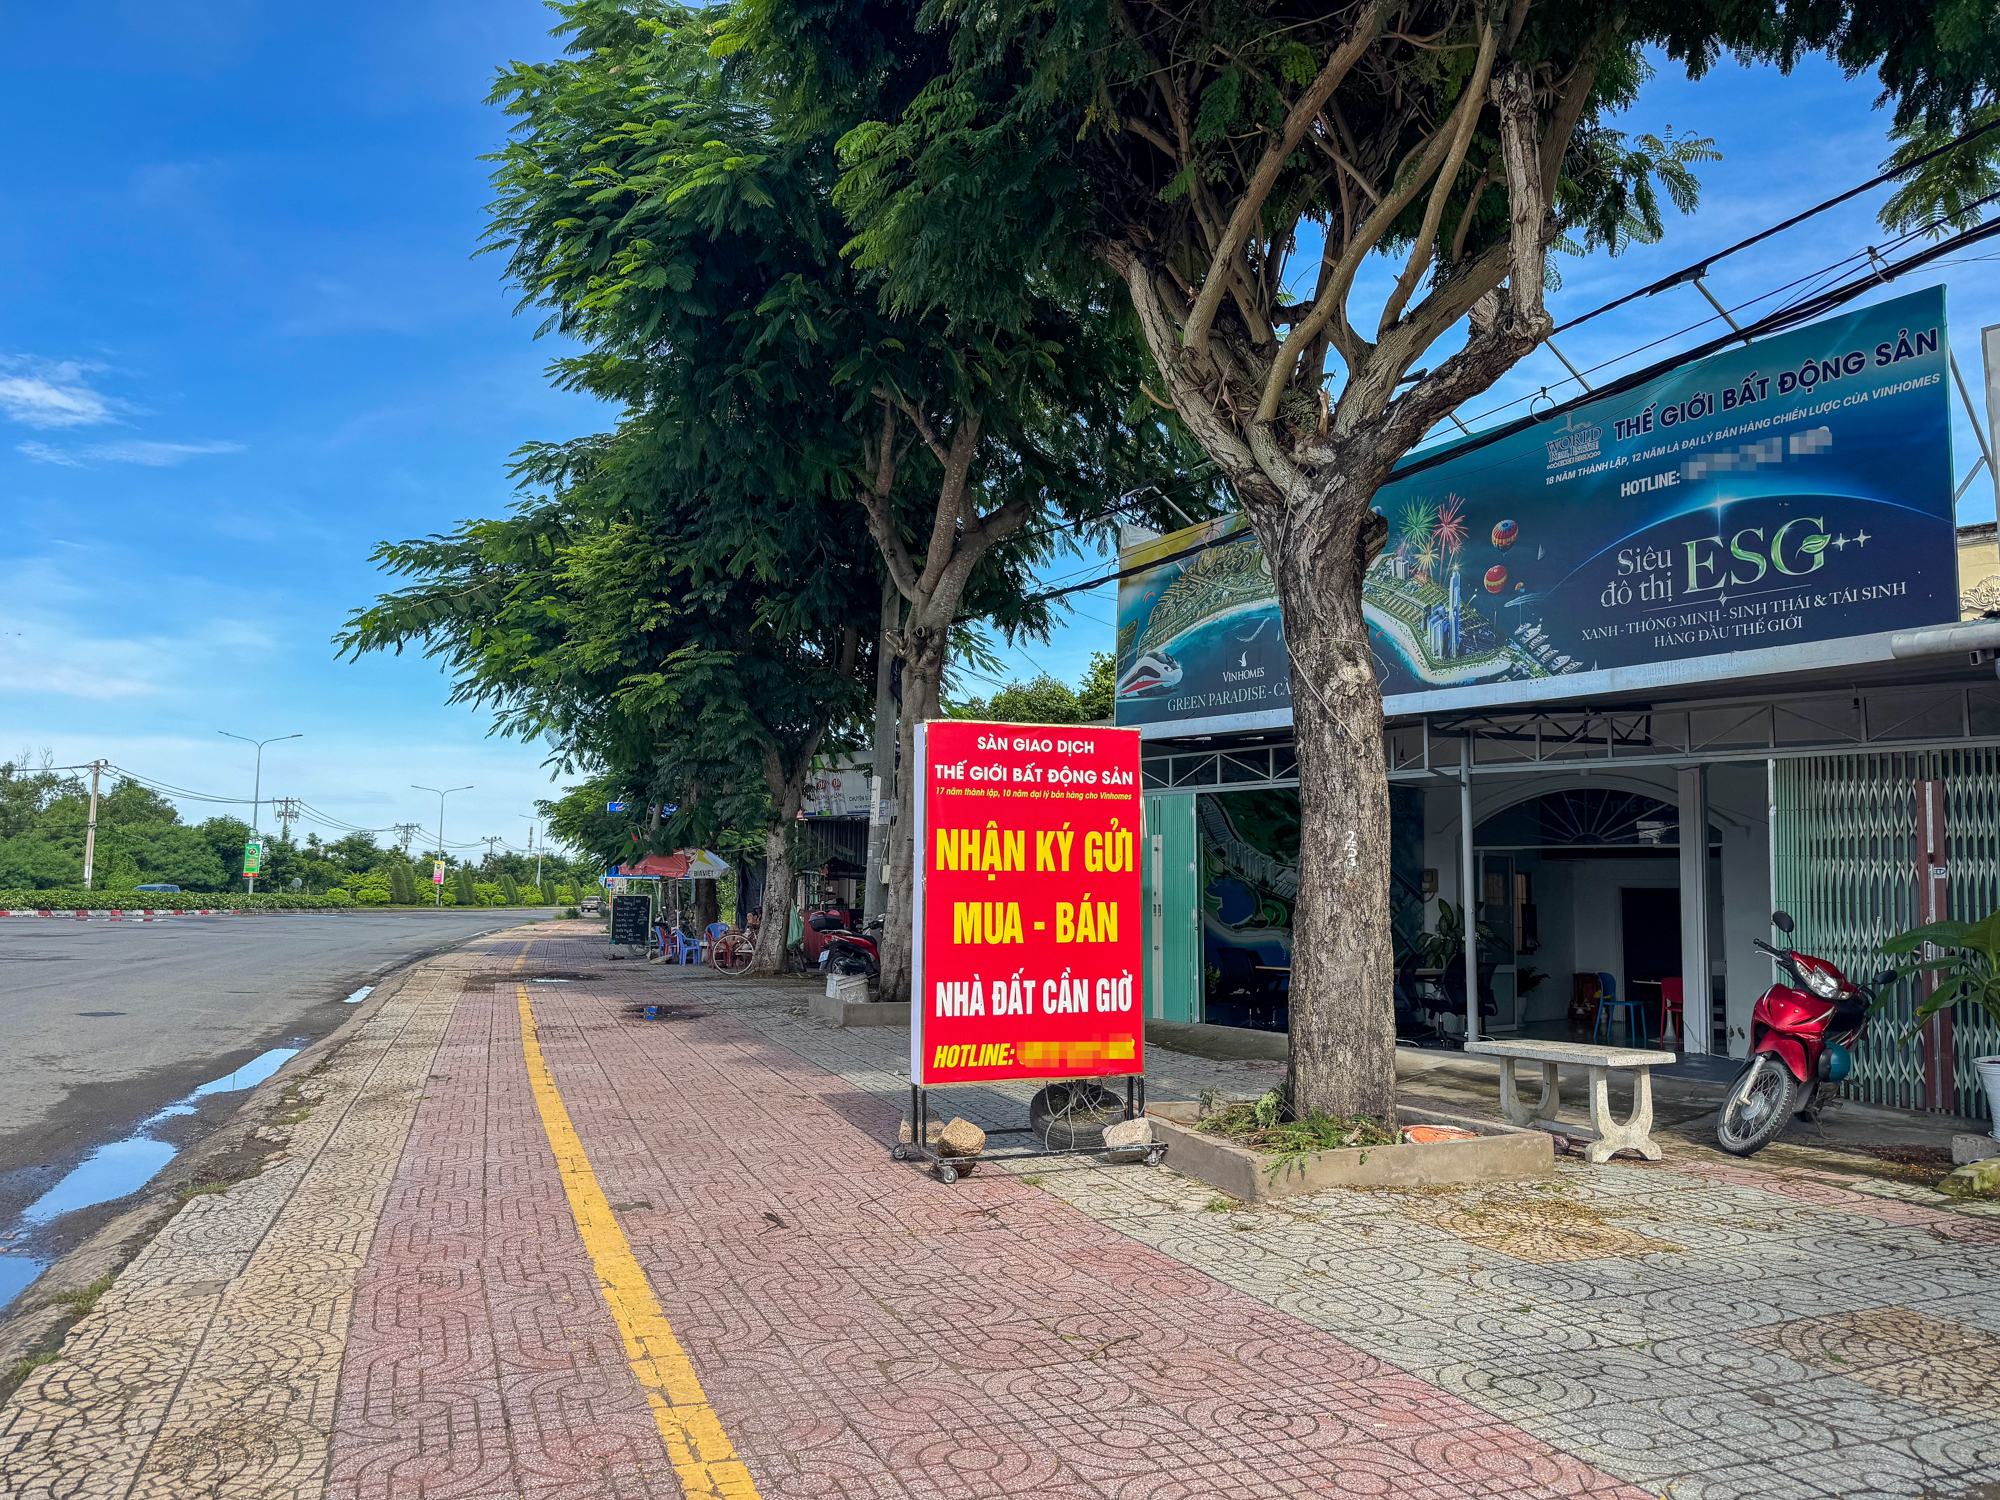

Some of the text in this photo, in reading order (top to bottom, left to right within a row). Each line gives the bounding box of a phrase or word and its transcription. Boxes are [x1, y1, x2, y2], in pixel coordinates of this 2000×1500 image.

[1614, 327, 1938, 441] THẾ GIỚI BẤT ĐỘNG SẢN
[1545, 373, 1941, 485] 18 NĂM THÀNH LẬP, 12 NĂM LÀ ĐẠI LÝ BÁN HÀNG CHIẾN LƯỢC CỦA VINHOMES
[1545, 426, 1603, 452] WORLD
[1620, 470, 1681, 497] HOTLINE:
[1617, 515, 1832, 595] Siêu ESG
[1600, 570, 1674, 608] đô thị
[1582, 625, 1618, 641] XANH
[1626, 617, 1676, 634] THÔNG
[1679, 609, 1720, 627] MINH
[1729, 602, 1767, 619] SINH
[1769, 594, 1811, 613] THÁI
[1813, 594, 1828, 607] &
[1829, 587, 1858, 605] TÁI
[1861, 581, 1907, 600] SINH
[1654, 613, 1804, 648] HÀNG ĐẦU THẾ GIỚI
[1222, 667, 1265, 683] VINHOMES
[1167, 694, 1206, 712] GREEN
[1208, 685, 1267, 707] PARADISE
[977, 733, 1095, 757] SÀN GIAO DỊCH
[934, 759, 1134, 788] THẾ GIỚI BẤT ĐỘNG SẢN
[936, 787, 1133, 801] 17 năm thành lập, 10 năm đại lý bán hàng cho Vinhomes
[936, 817, 1133, 881] NHẬN KÝ GỬI
[953, 892, 1118, 945] MUA - BÁN
[935, 966, 1133, 1017] NHÀ ĐẤT CẦN GIỜ
[933, 1043, 1015, 1069] HOTLINE:
